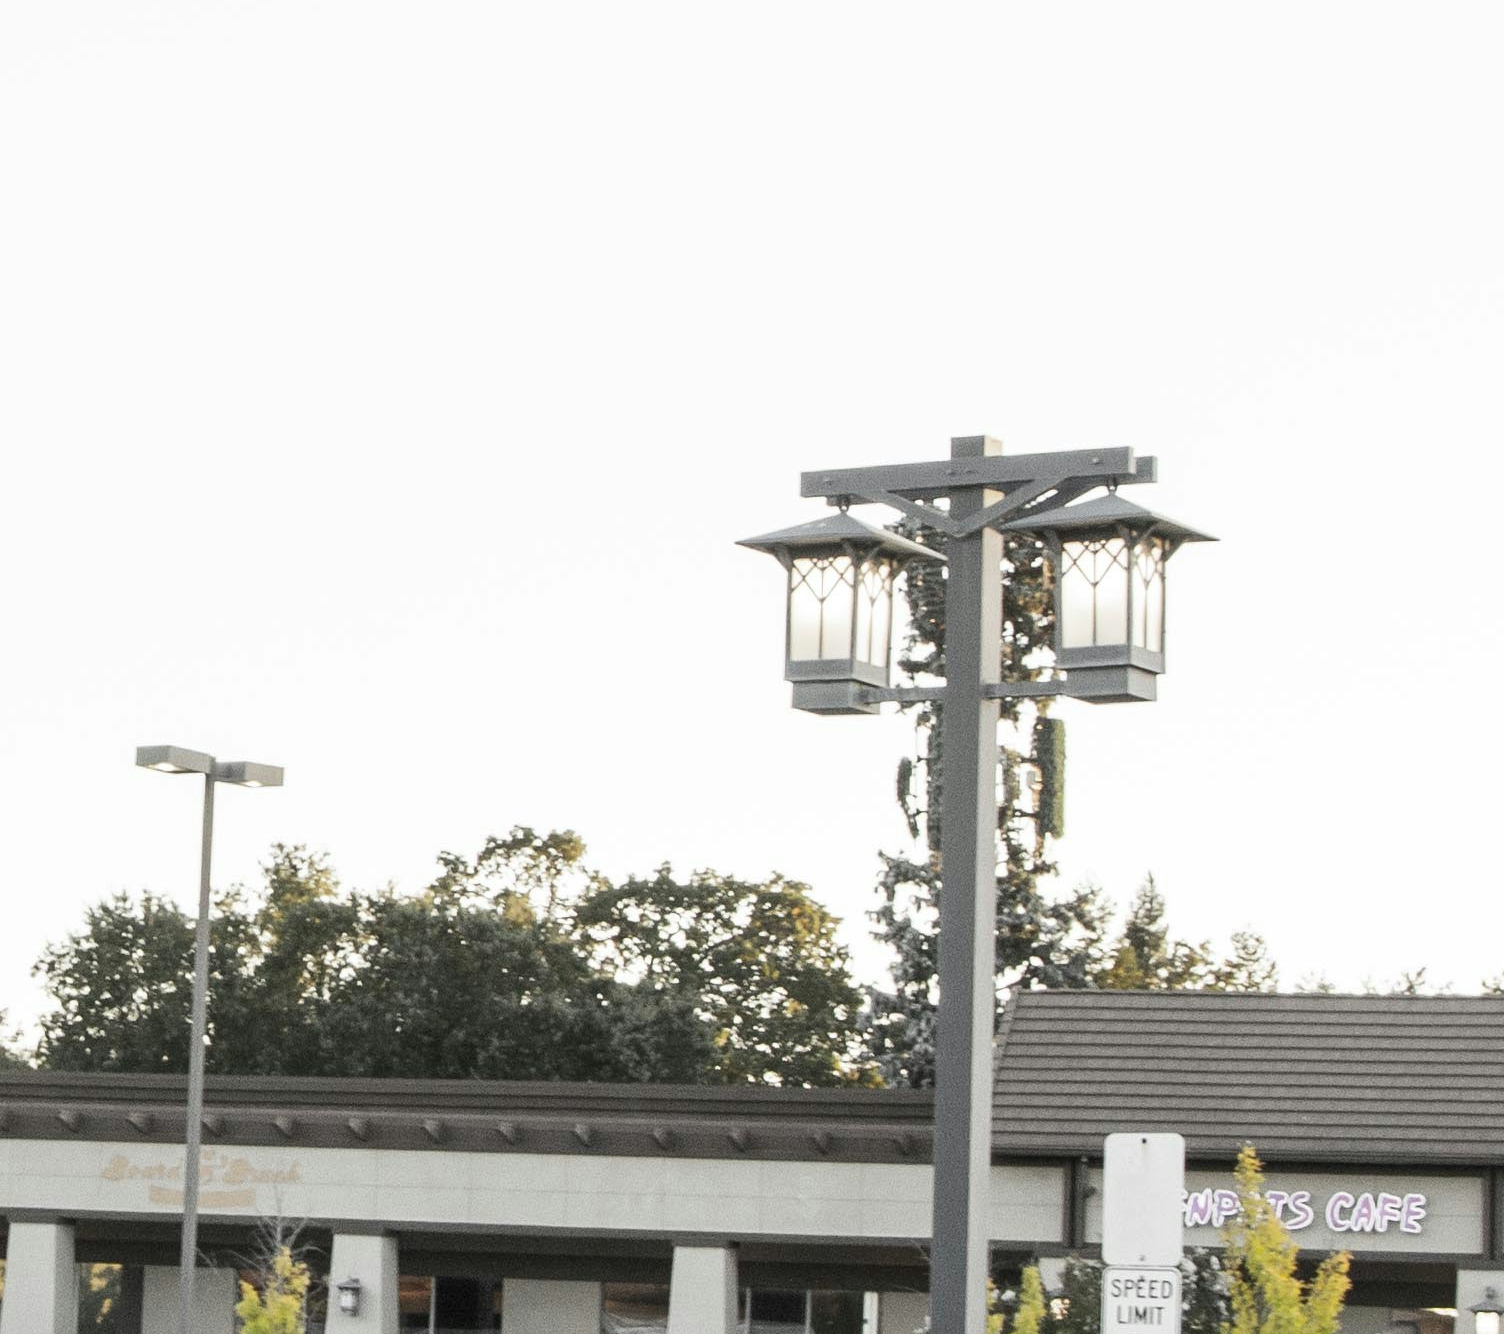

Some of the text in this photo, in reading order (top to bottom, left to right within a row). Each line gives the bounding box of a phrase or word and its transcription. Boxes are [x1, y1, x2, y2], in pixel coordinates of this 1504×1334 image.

[1325, 1191, 1427, 1234] CAFE
[1111, 1278, 1174, 1299] SPEED
[1117, 1305, 1164, 1325] LIMIT
